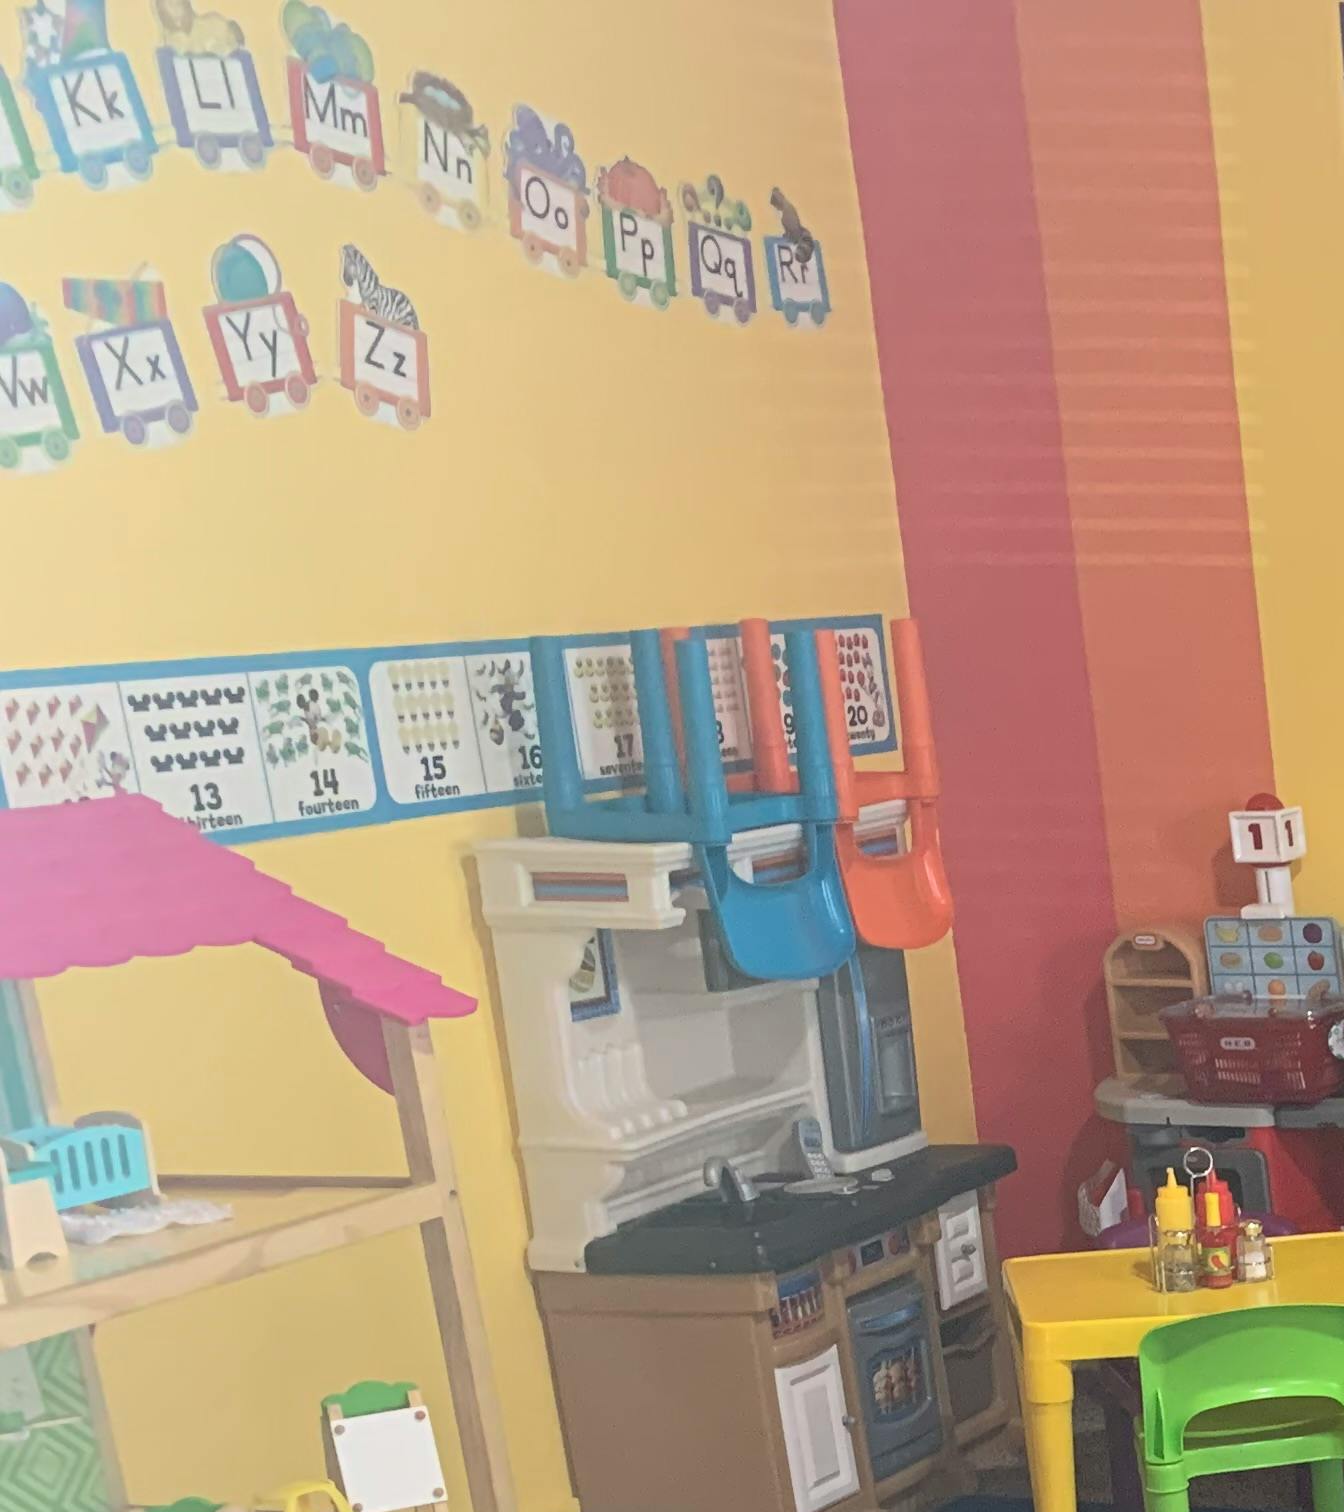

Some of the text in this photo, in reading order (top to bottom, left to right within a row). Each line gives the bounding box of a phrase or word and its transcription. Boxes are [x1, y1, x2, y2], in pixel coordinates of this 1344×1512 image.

[61, 68, 125, 127] Kk
[303, 77, 368, 138] Mm
[423, 120, 474, 185] Nn
[524, 175, 570, 231] Oo
[617, 211, 655, 277] Pp
[699, 234, 744, 299] Qq
[777, 244, 811, 286] Rr
[225, 311, 278, 377] Yy
[365, 320, 408, 378] Zz
[104, 335, 167, 391] Xx
[846, 705, 869, 727] 20
[613, 733, 635, 759] 17
[848, 728, 876, 742] wenty
[420, 755, 448, 782] 15
[517, 744, 543, 771] 16
[309, 768, 340, 797] 14
[413, 782, 461, 800] fifteen
[513, 772, 543, 788] sixte
[189, 782, 224, 812] 13
[298, 796, 360, 818] fourteen
[184, 812, 244, 832] hirteen
[1247, 822, 1264, 851] 1
[1284, 819, 1294, 847] 1
